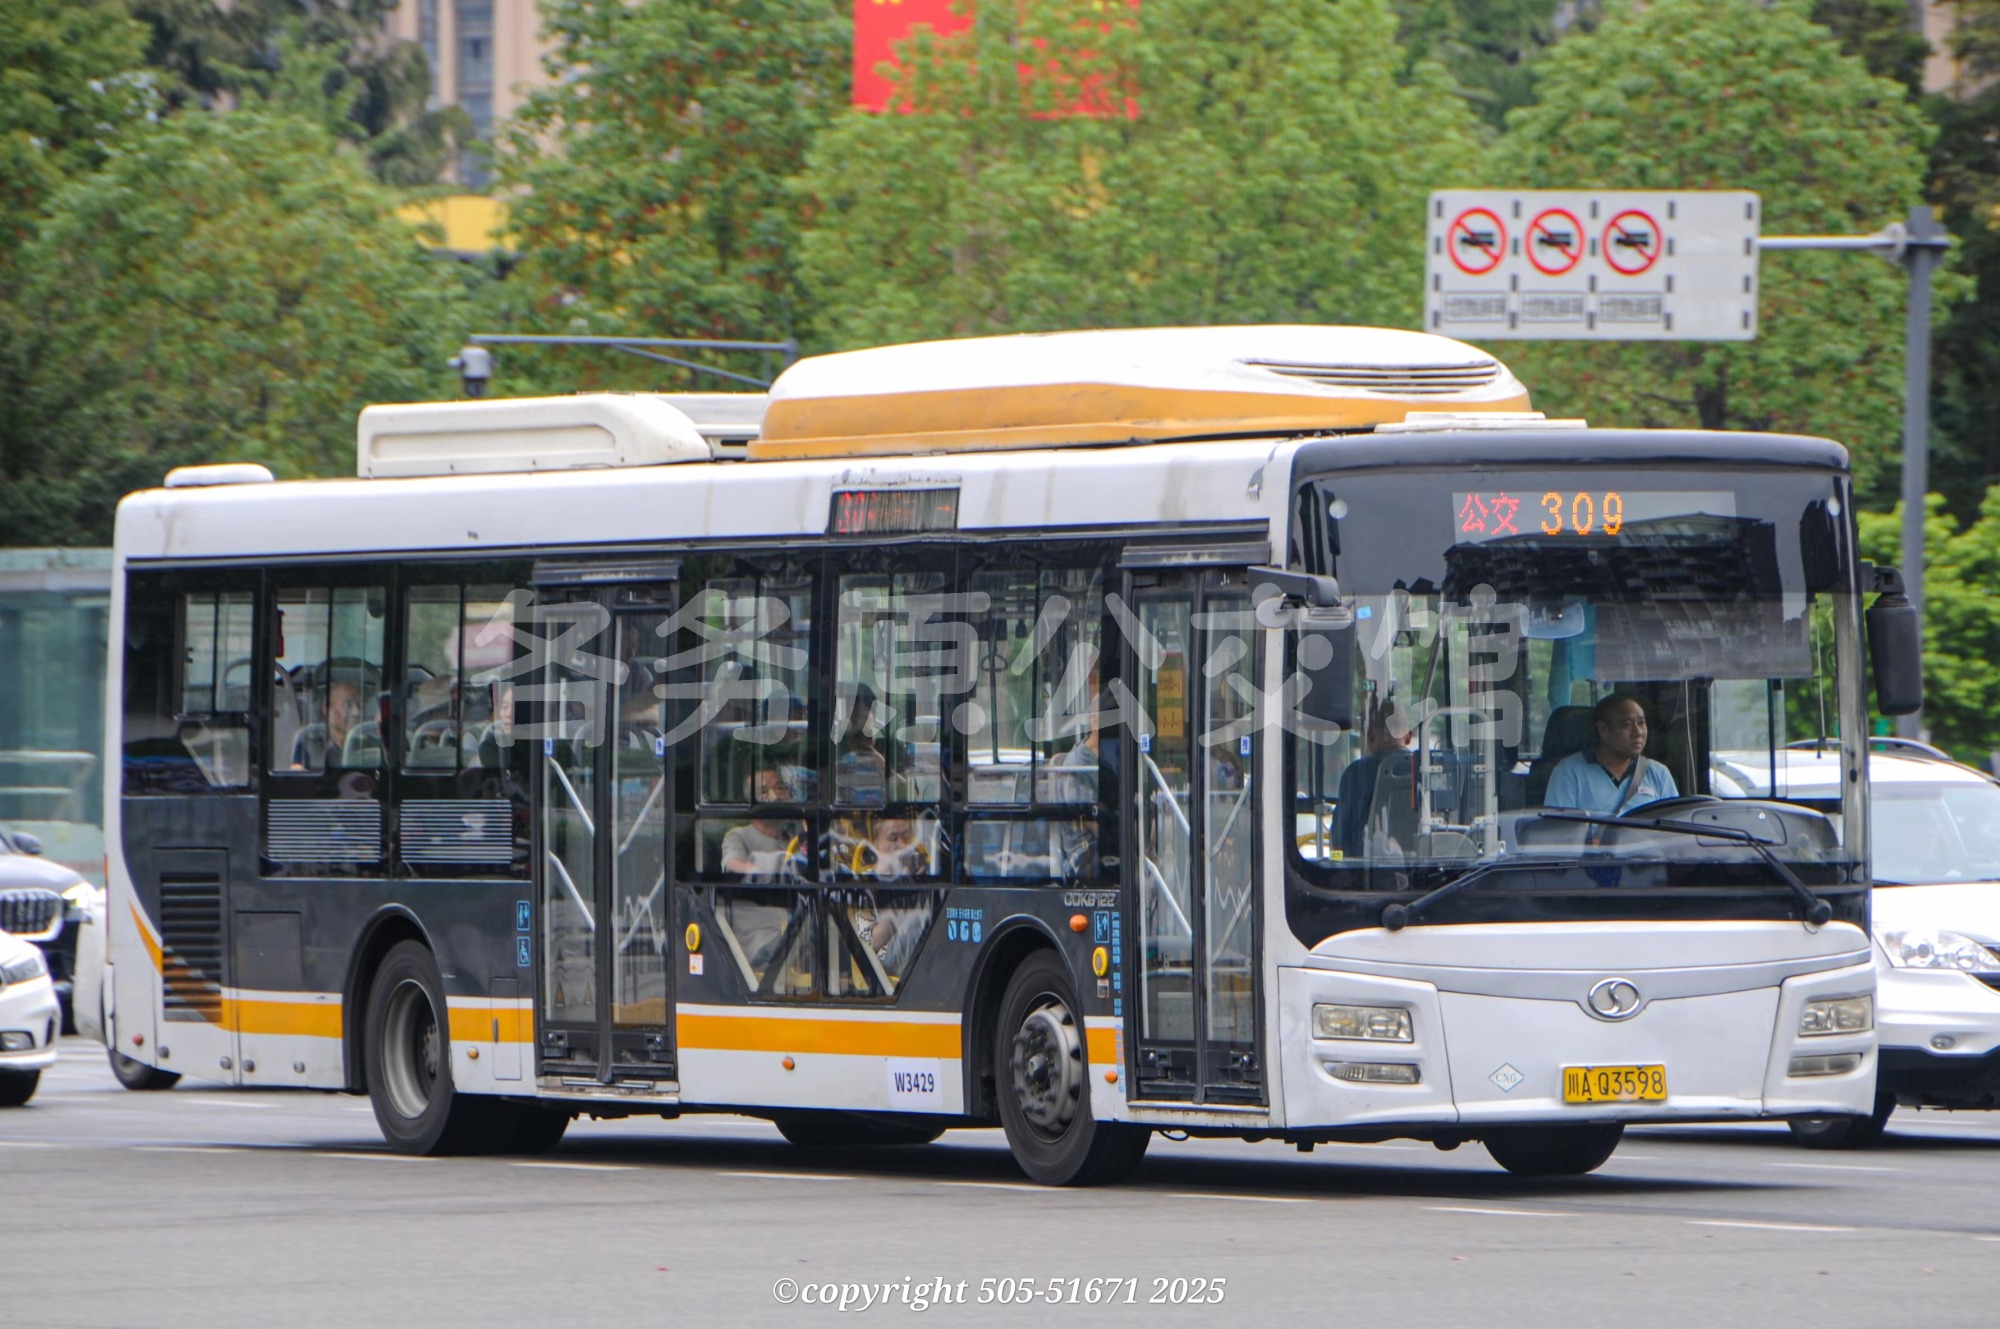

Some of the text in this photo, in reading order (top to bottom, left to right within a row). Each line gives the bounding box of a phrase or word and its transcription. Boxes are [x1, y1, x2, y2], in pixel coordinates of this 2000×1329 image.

[1459, 490, 1624, 535] 公交 309
[894, 1072, 935, 1093] W3429
[1495, 1072, 1517, 1083] CNG
